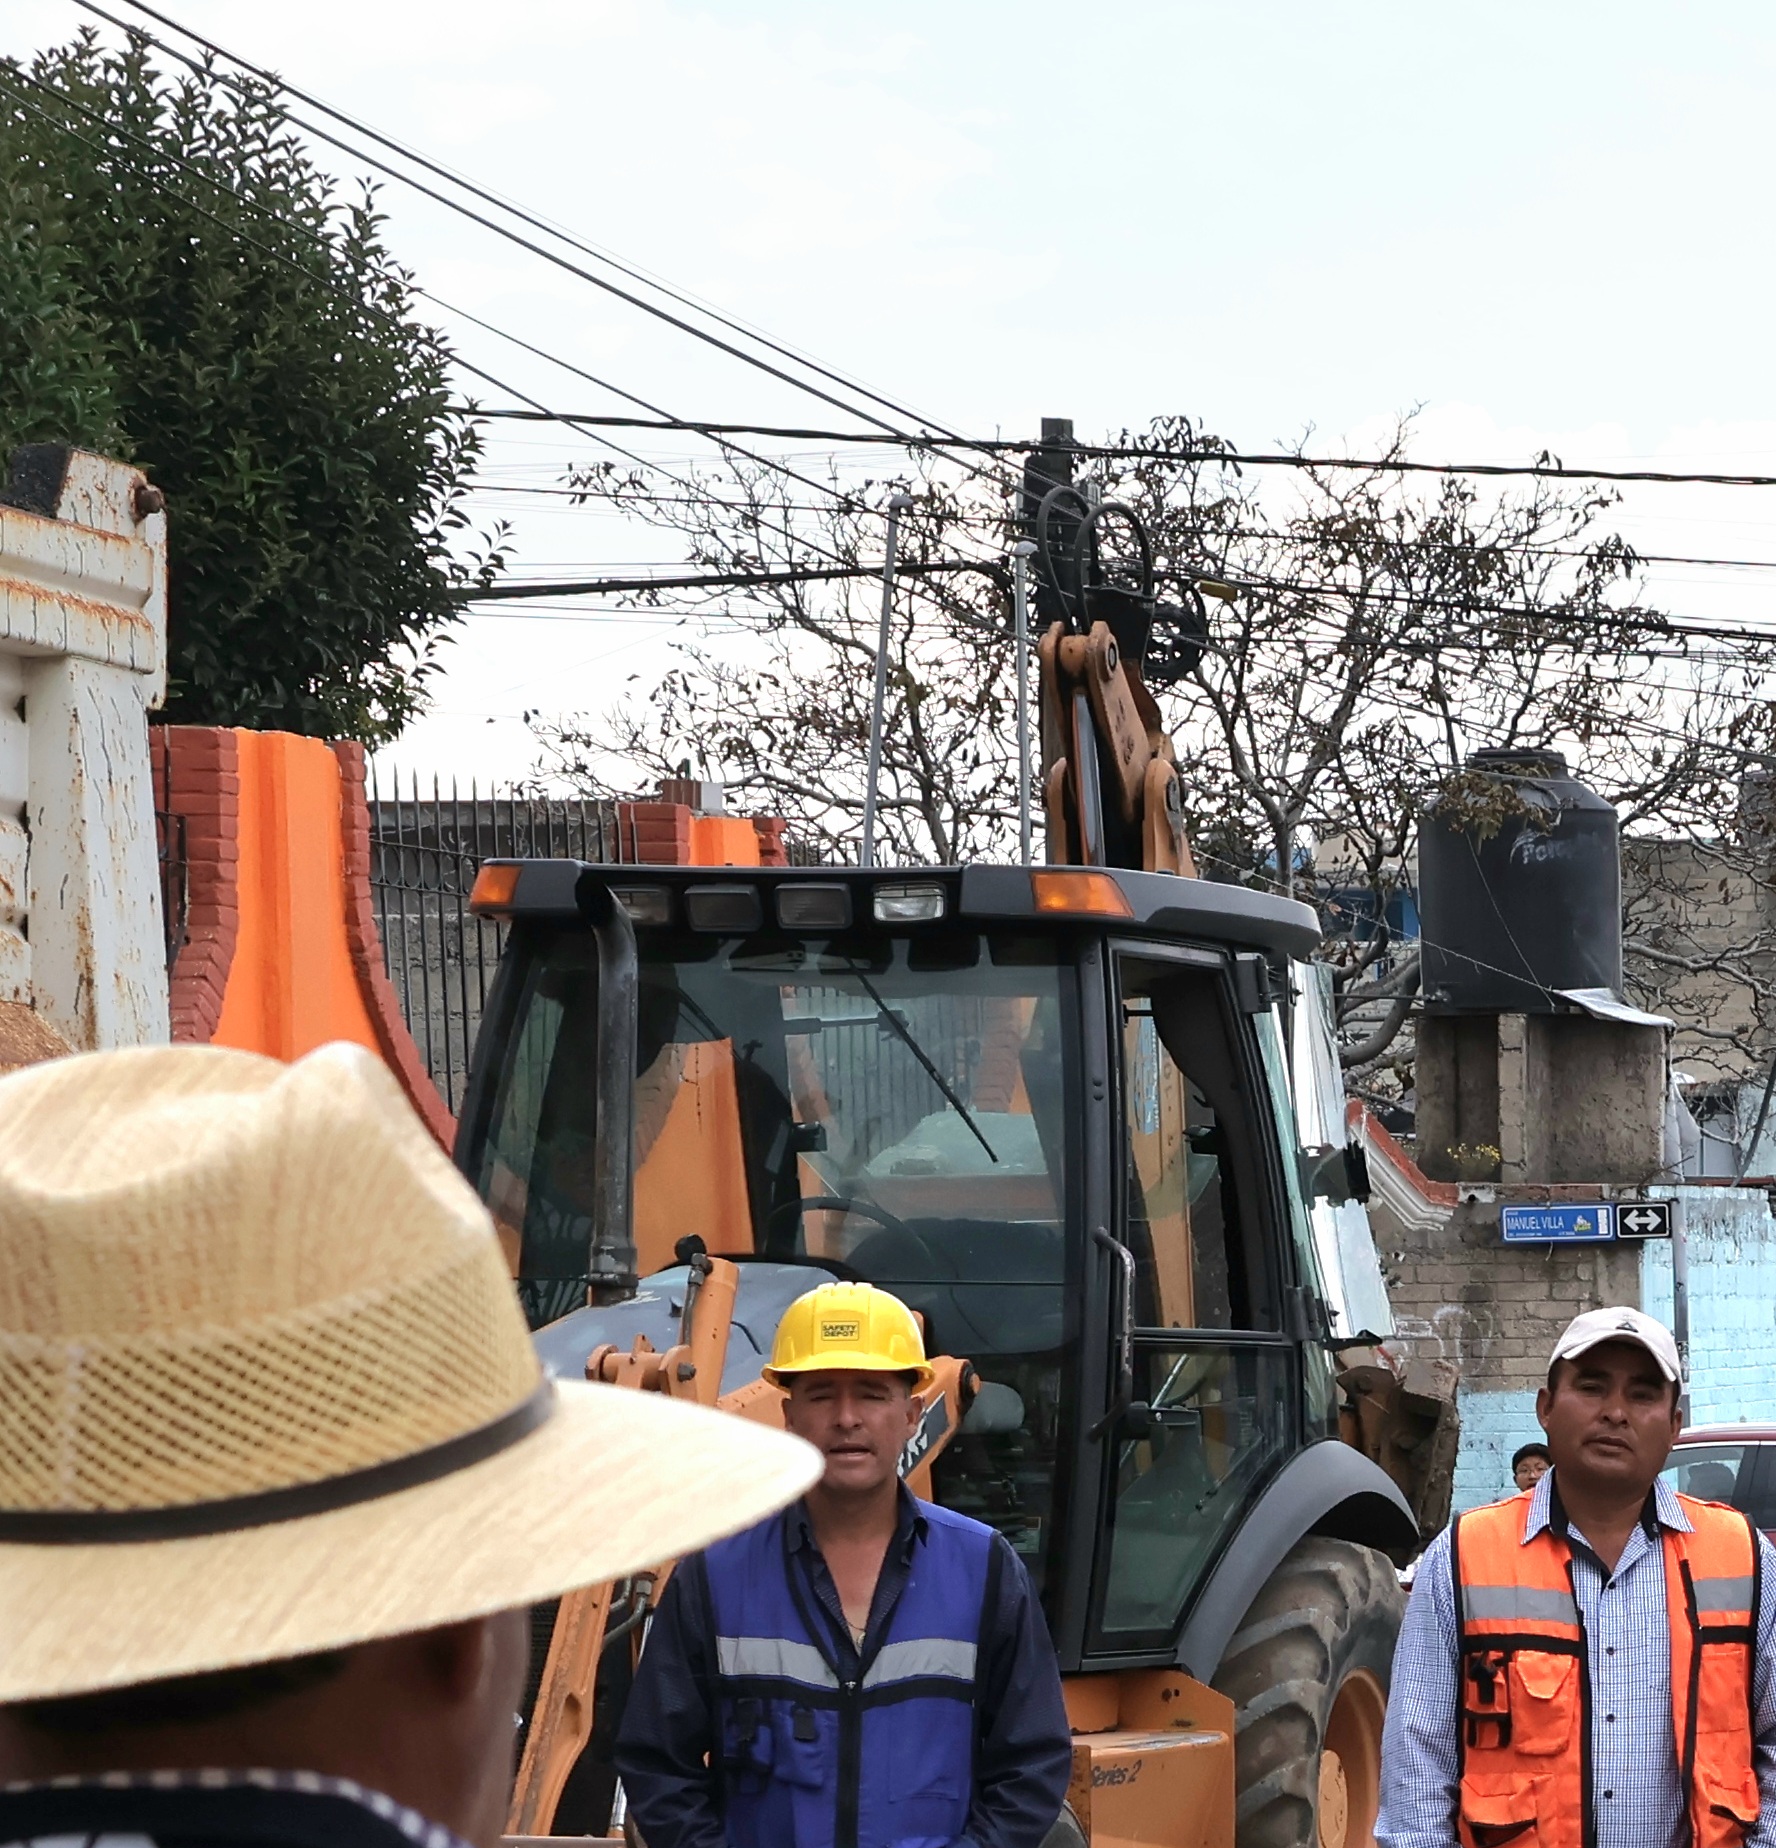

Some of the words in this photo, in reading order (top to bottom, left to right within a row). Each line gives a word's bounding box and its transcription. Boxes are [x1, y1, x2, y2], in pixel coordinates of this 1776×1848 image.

[1506, 1217, 1541, 1231] MANUEL
[1541, 1216, 1565, 1230] VILLA
[1092, 1764, 1129, 1788] Series
[1127, 1759, 1142, 1784] 2
